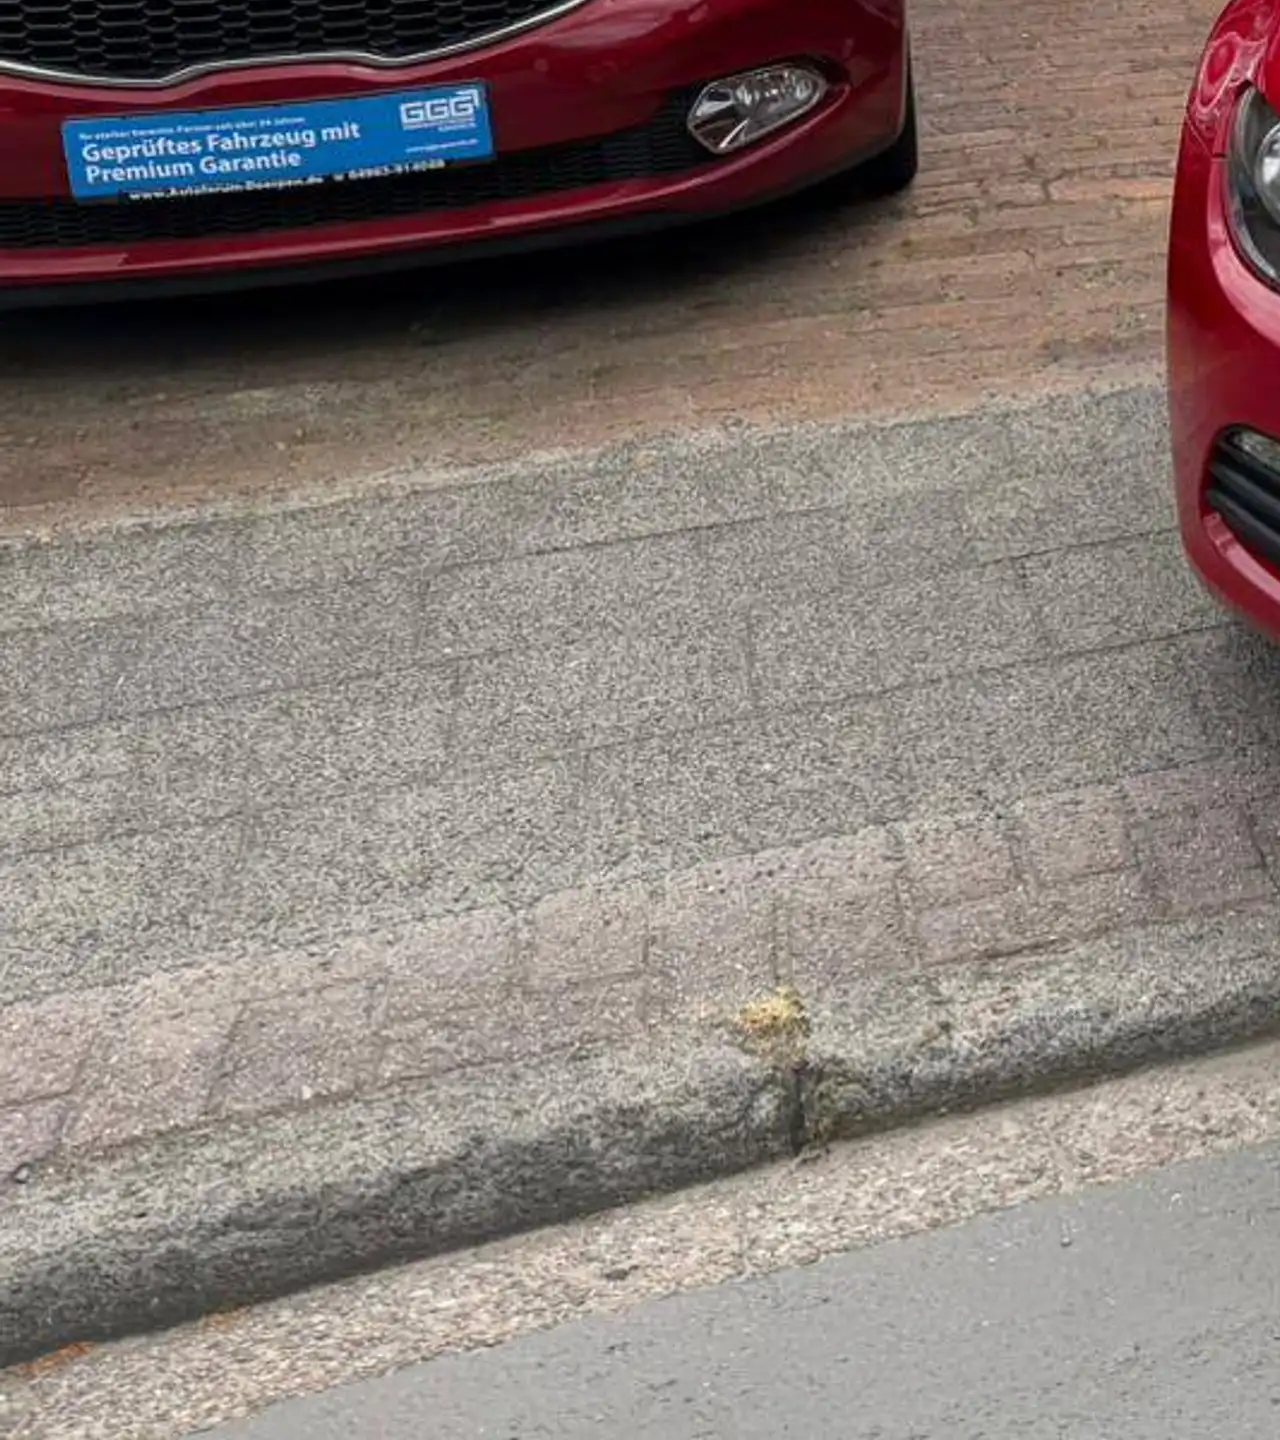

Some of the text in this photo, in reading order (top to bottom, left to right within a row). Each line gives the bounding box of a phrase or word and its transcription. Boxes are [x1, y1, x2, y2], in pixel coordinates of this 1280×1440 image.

[82, 137, 203, 165] Geprüftes
[207, 128, 316, 153] Fahrzeug
[321, 121, 362, 143] mit
[85, 149, 302, 186] Premium Garantie
